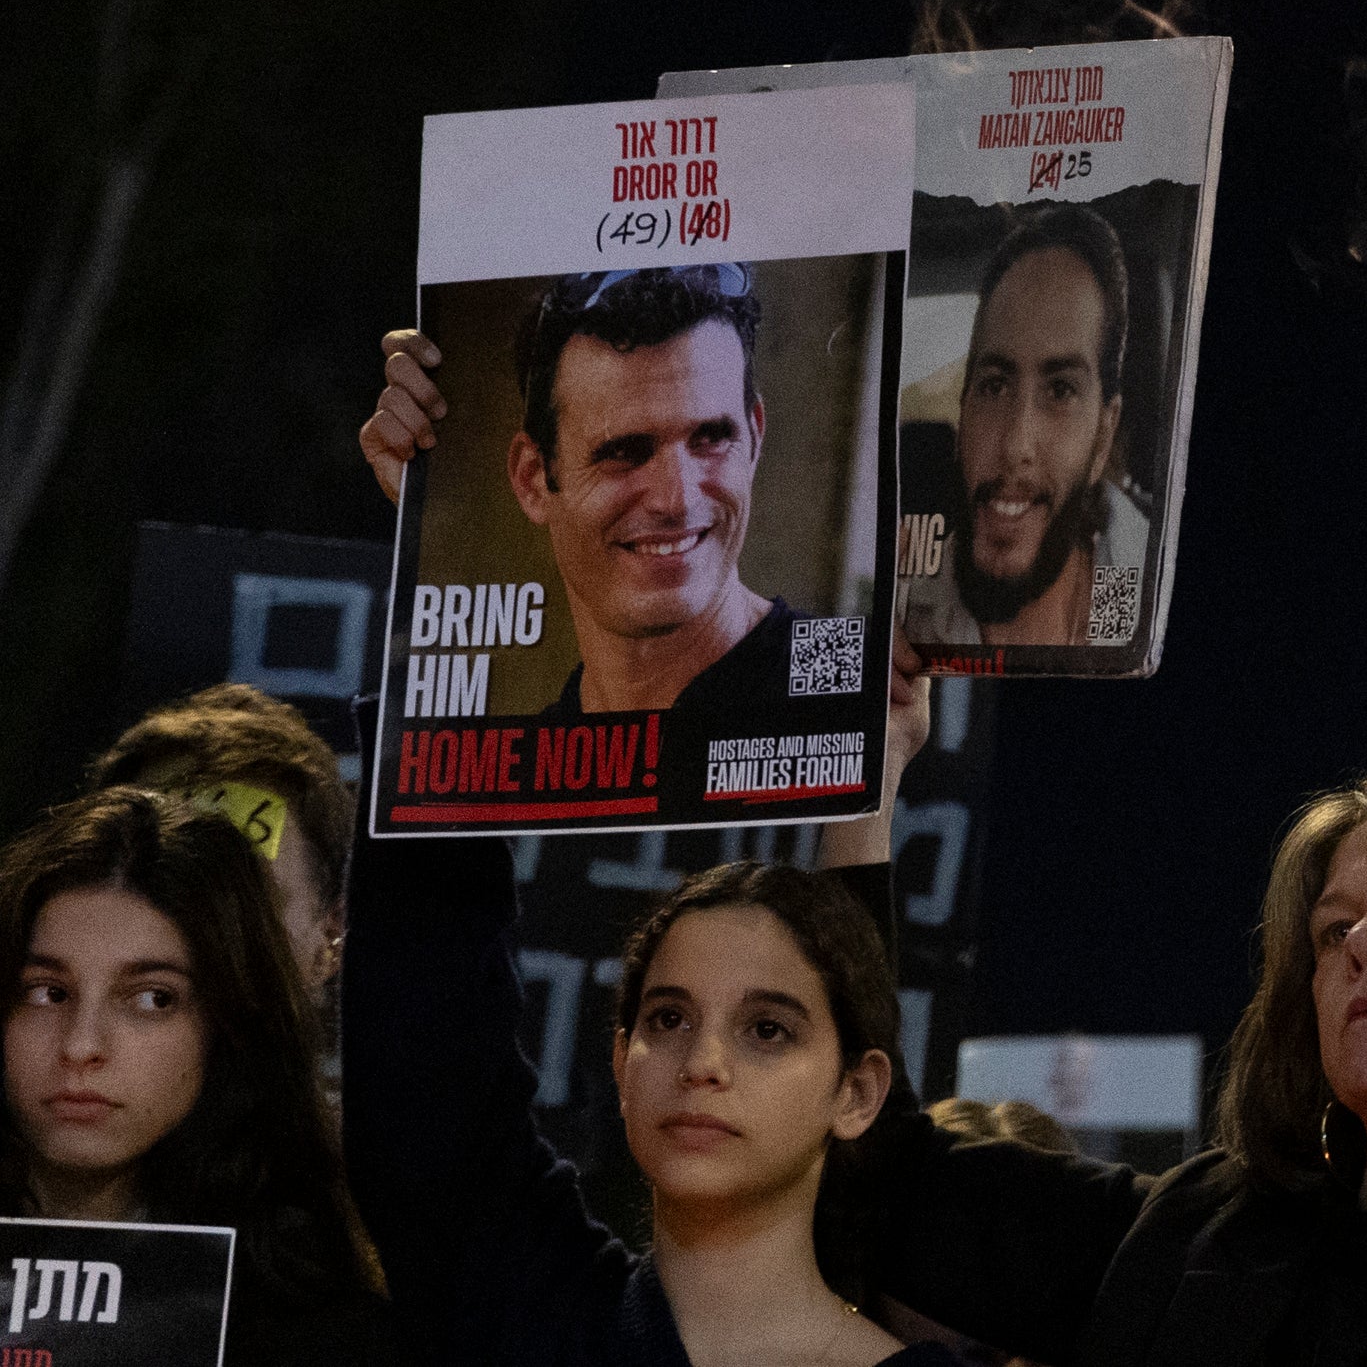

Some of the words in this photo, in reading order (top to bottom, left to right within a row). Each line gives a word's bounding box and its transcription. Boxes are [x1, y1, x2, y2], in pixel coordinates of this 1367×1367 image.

[1074, 65, 1104, 107] מתן
[615, 121, 657, 159] אור
[665, 116, 718, 156] דרור
[978, 112, 1032, 149] MATAN
[1033, 106, 1125, 146] ZANGAUKER
[613, 162, 678, 202] DROR
[685, 160, 718, 197] OR
[1064, 151, 1092, 180] 25
[596, 209, 671, 253] (49)
[900, 513, 945, 576] ING
[410, 582, 545, 648] BRING
[404, 654, 490, 718] HIM
[398, 729, 525, 795] HOME
[534, 713, 660, 791] NOW!
[708, 737, 775, 761] HOSTAGES
[776, 736, 804, 758] AND
[806, 732, 865, 756] MISSING
[706, 759, 792, 793] FAMILIES
[795, 754, 864, 789] FORUM
[9, 1257, 122, 1333] מתן
